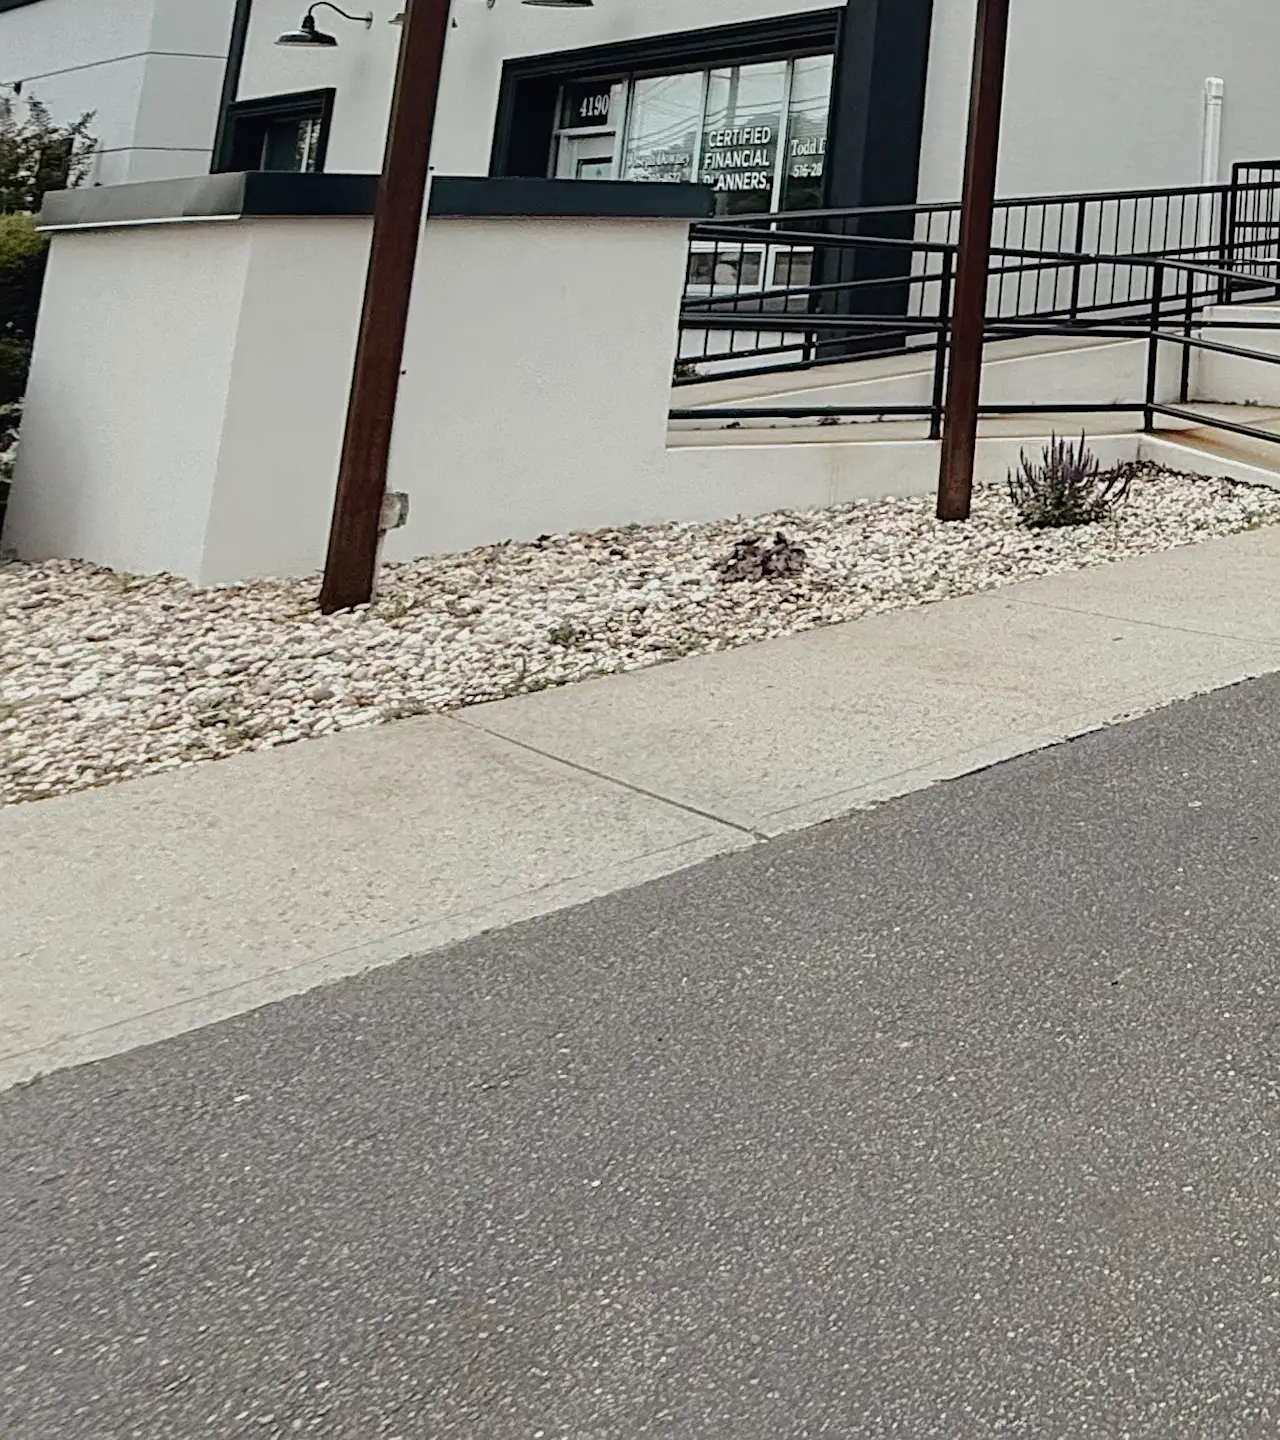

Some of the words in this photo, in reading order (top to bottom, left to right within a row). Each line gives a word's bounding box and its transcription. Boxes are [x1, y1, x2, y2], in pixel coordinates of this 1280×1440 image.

[579, 94, 610, 117] 4190
[708, 126, 771, 148] CERTIFIED
[791, 137, 817, 157] Todd
[703, 148, 770, 169] FINANCIAL
